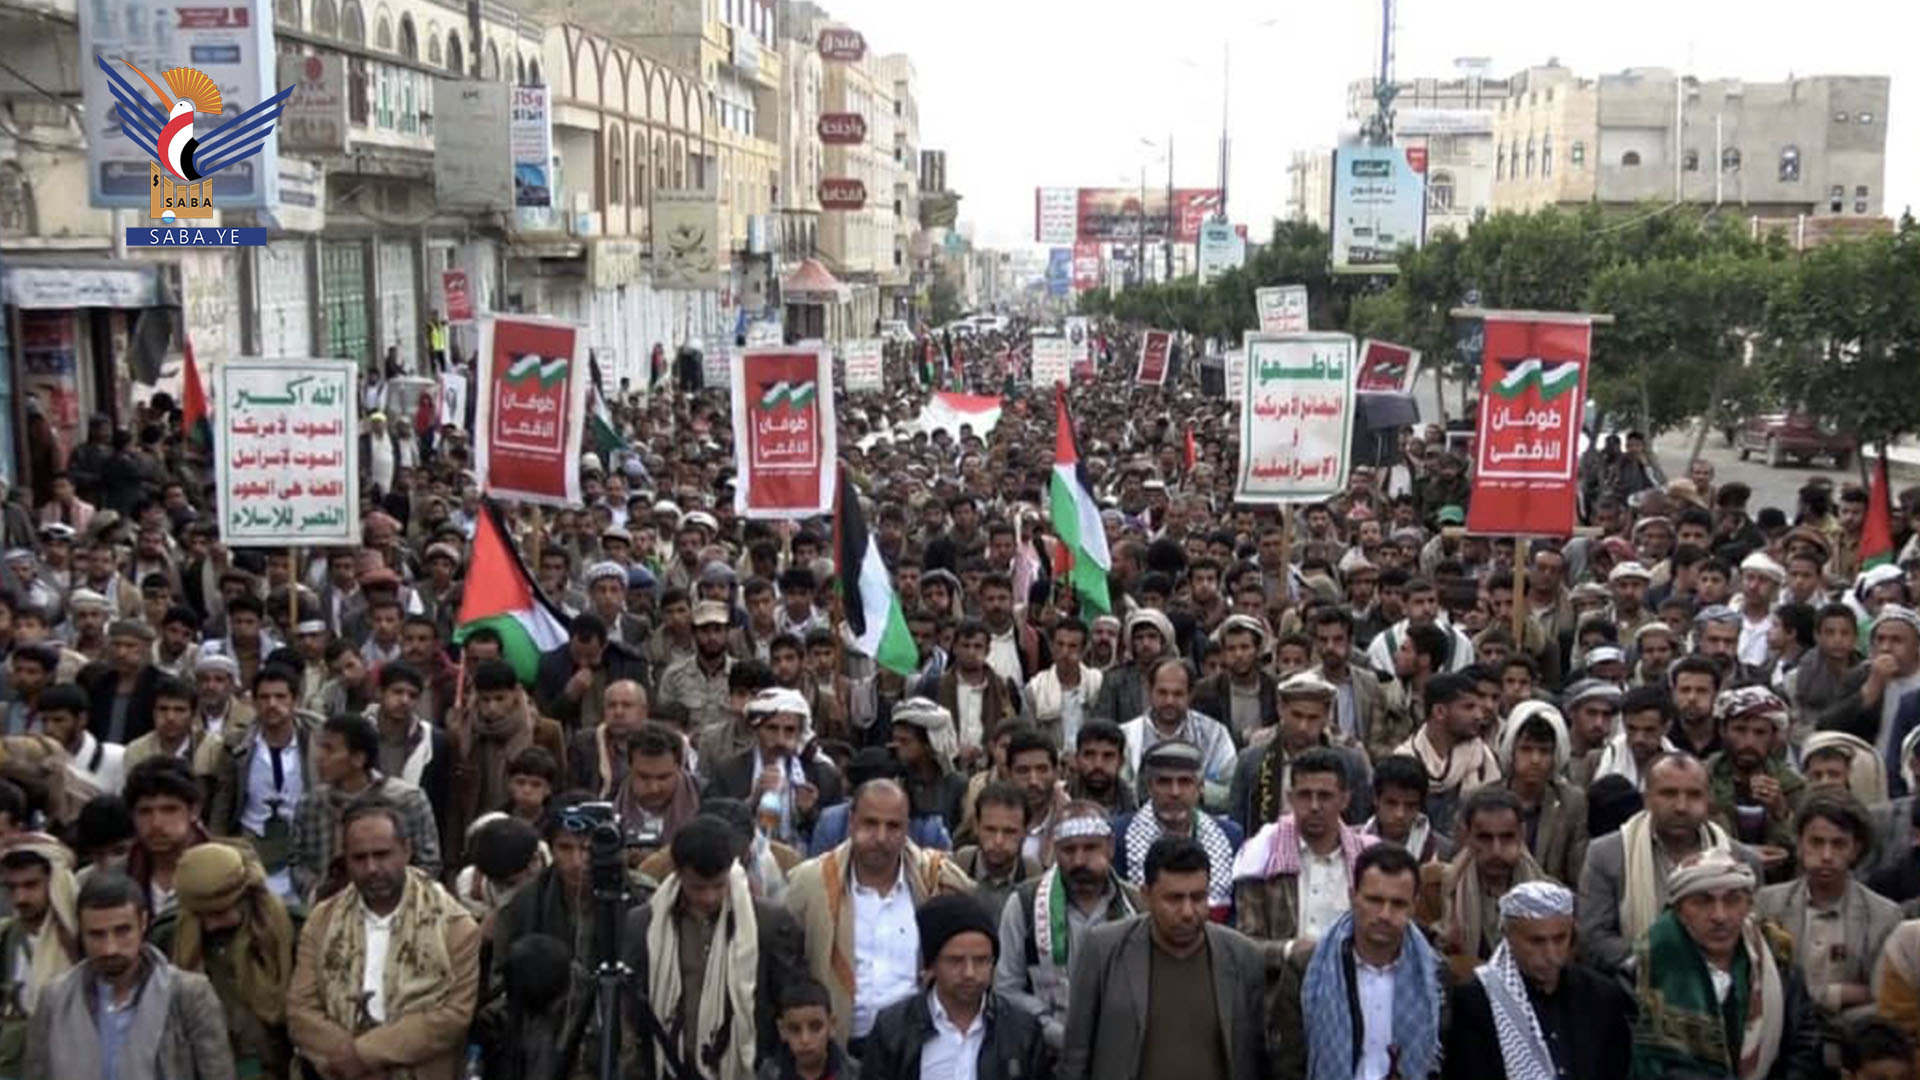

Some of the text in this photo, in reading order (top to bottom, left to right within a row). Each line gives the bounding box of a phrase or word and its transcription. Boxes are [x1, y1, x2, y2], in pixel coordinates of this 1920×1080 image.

[1254, 353, 1344, 387] قاطعوا
[311, 377, 343, 405] الله
[502, 390, 556, 414] طوفان
[292, 419, 343, 440] الموت
[759, 415, 808, 434] طوفان
[1491, 405, 1561, 433] طوفان
[1292, 427, 1298, 447] و
[292, 449, 343, 471] الموت
[231, 479, 276, 501] اليهود
[278, 480, 302, 501] على
[298, 504, 344, 531] النصر
